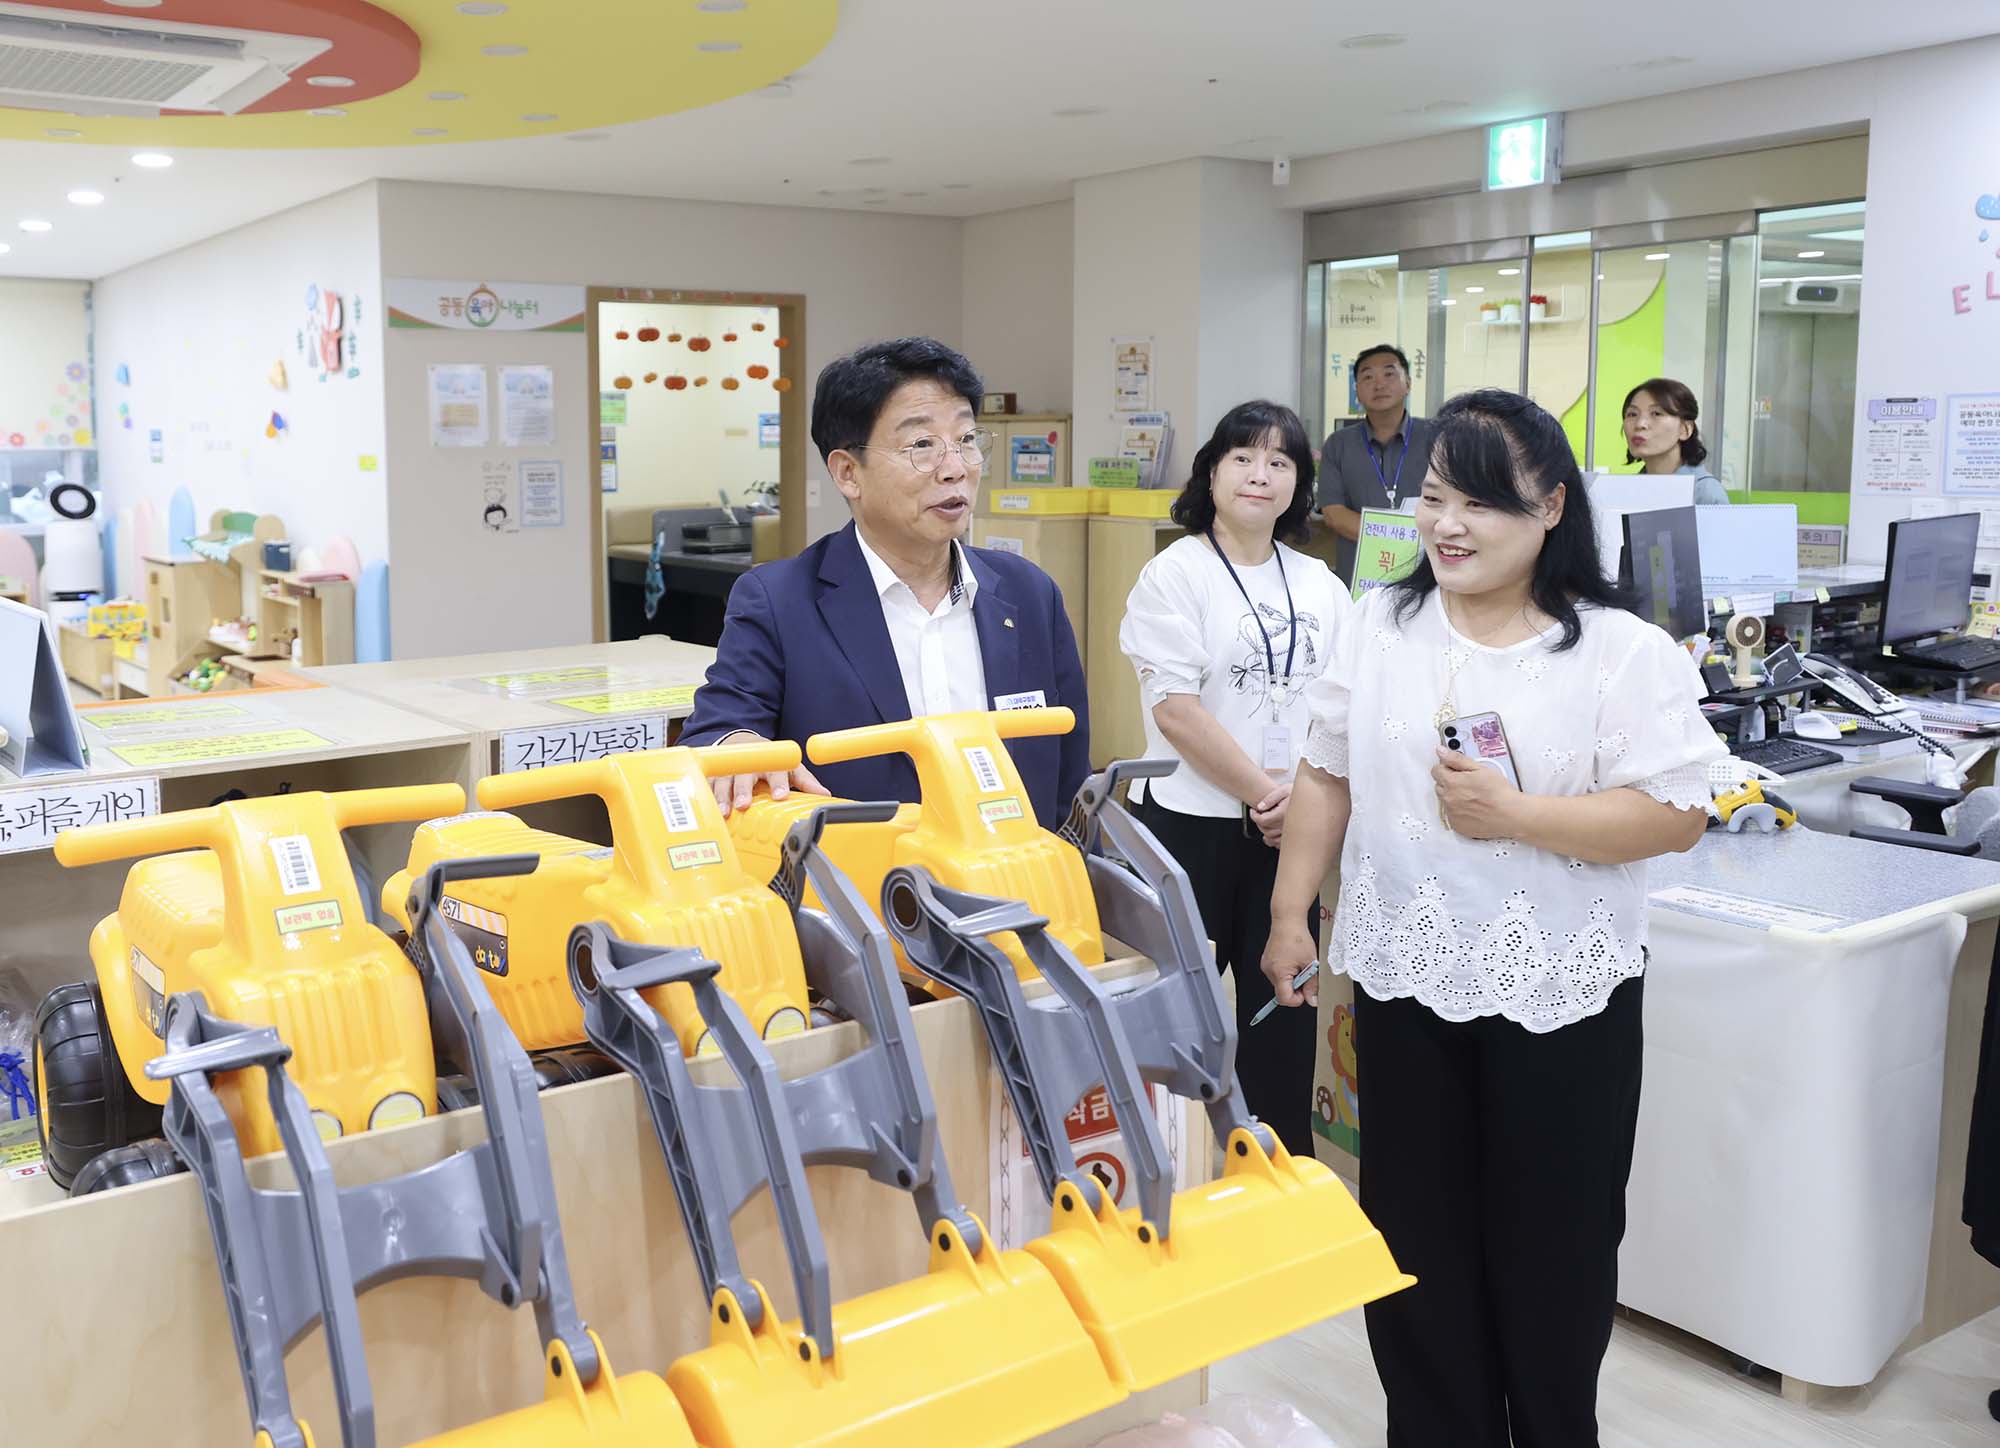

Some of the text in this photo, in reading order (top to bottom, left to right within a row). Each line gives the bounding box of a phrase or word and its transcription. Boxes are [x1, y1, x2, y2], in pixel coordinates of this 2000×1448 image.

[438, 296, 464, 318] 공동
[1365, 522, 1388, 537] 건전지
[1390, 525, 1406, 541] 사용
[1378, 550, 1396, 574] 꼭!
[515, 723, 655, 771] 감각/통합
[443, 898, 461, 919] 4571
